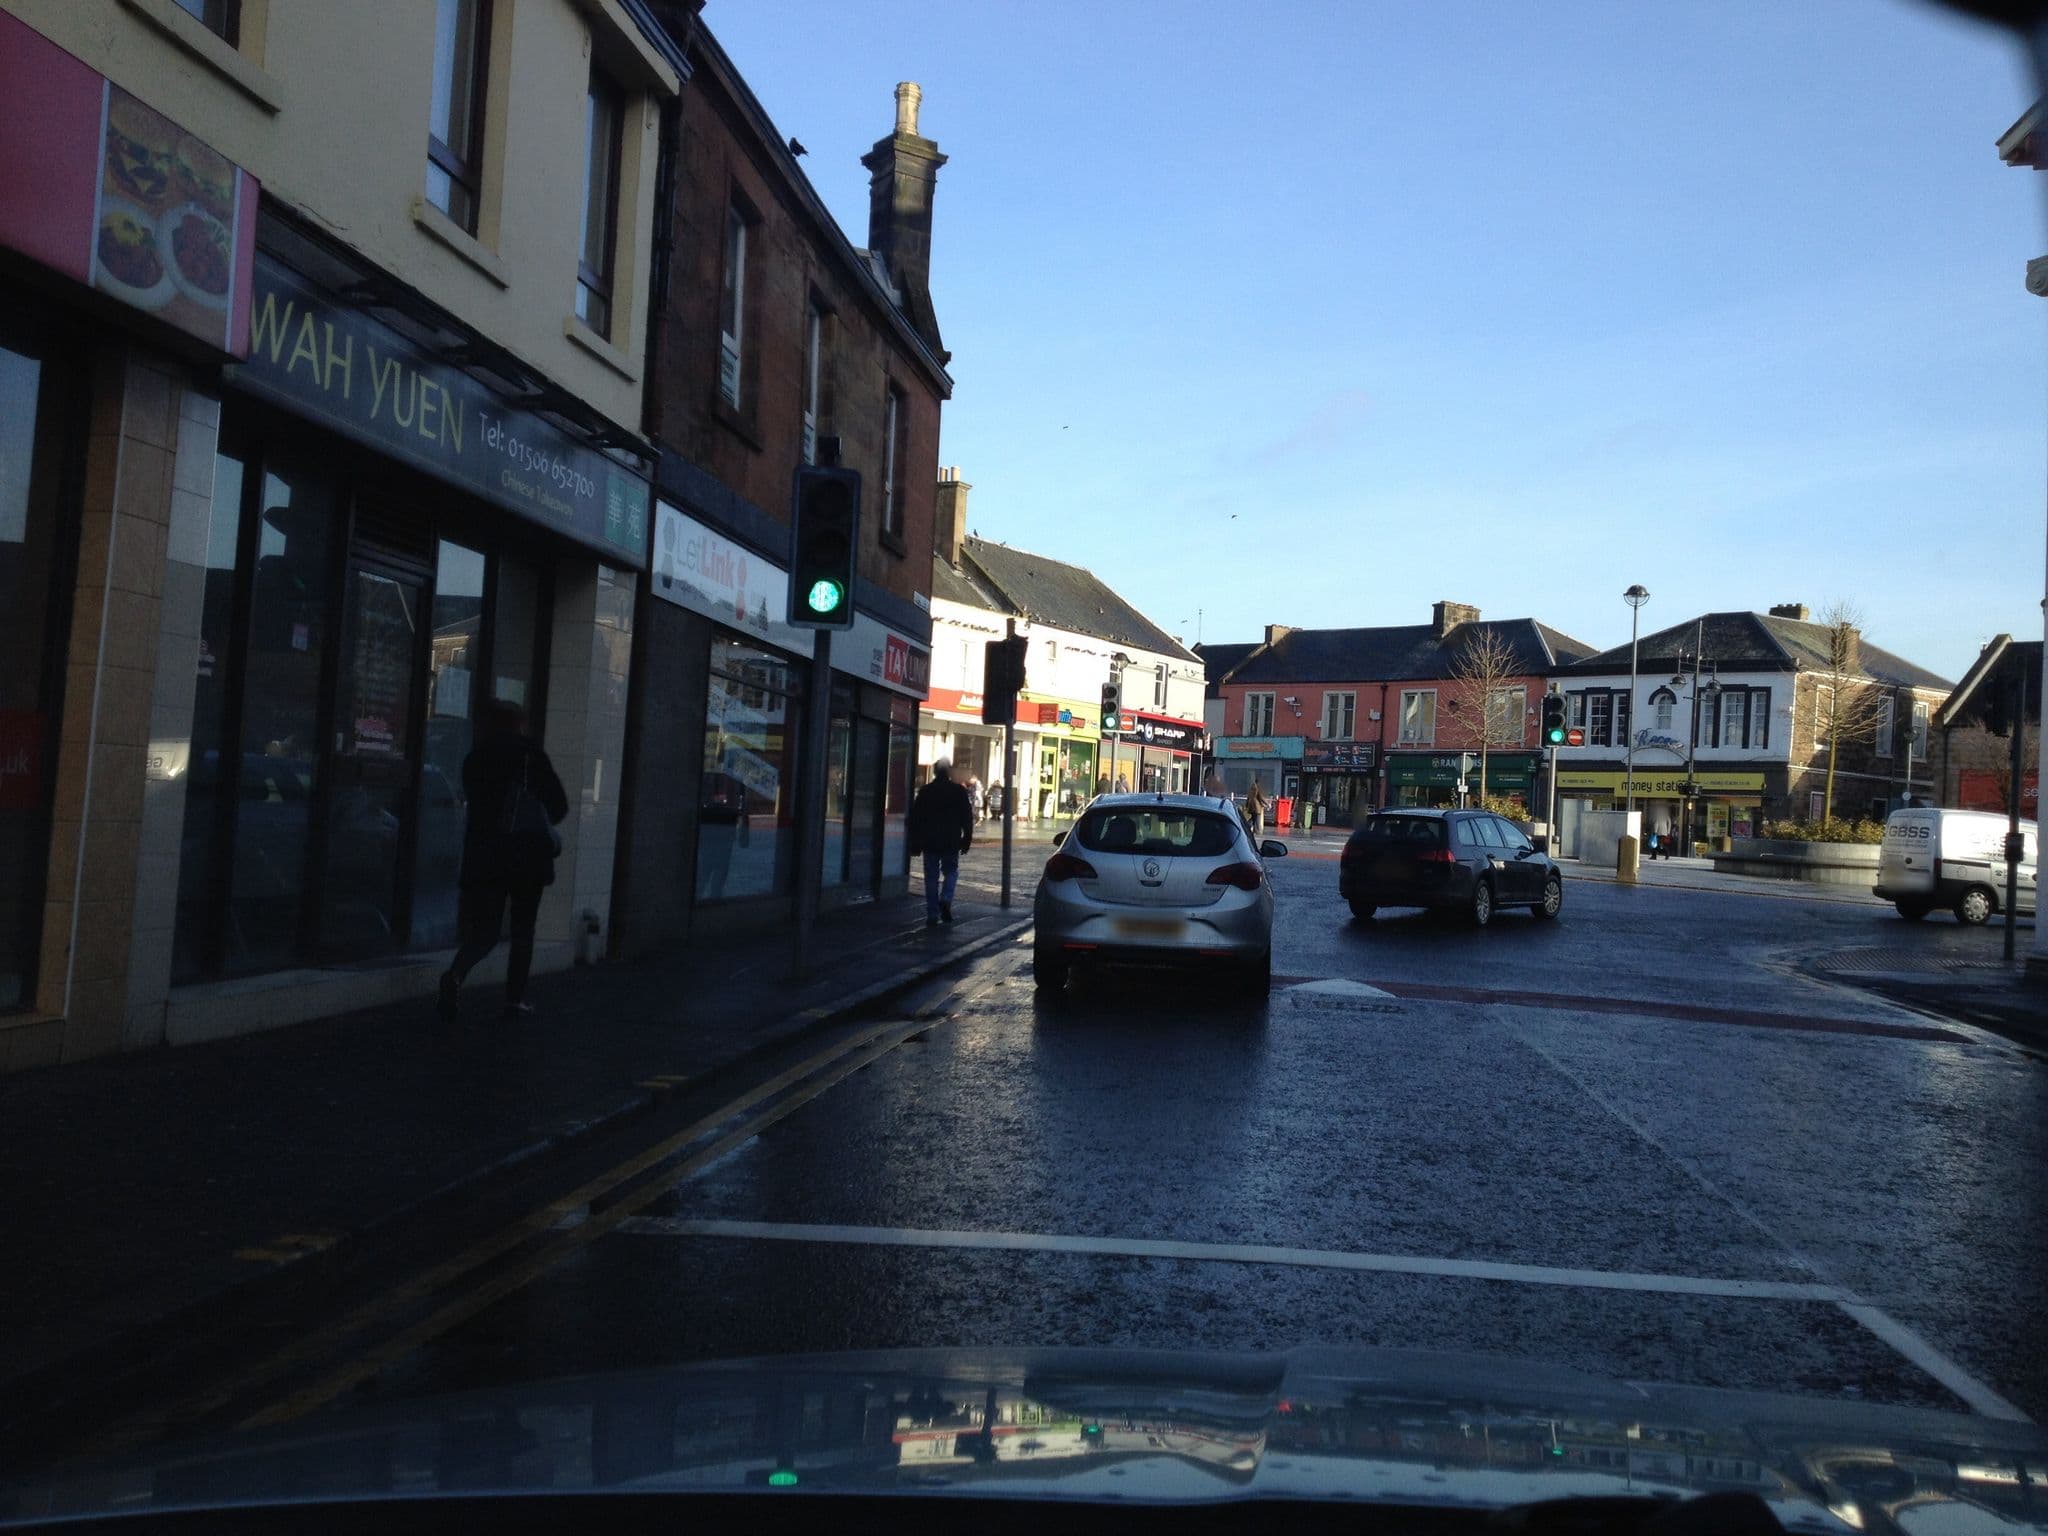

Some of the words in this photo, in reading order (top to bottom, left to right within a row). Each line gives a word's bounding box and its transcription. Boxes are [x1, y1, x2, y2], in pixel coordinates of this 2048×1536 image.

[251, 292, 353, 400] WAH
[366, 344, 464, 455] YUEN
[479, 412, 504, 452] Tel:
[508, 438, 549, 474] 01506
[551, 457, 595, 499] 652700
[502, 470, 535, 498] Chinese
[1154, 726, 1186, 739] SHARP
[1621, 782, 1652, 792] money
[1889, 825, 1930, 839] GBSS
